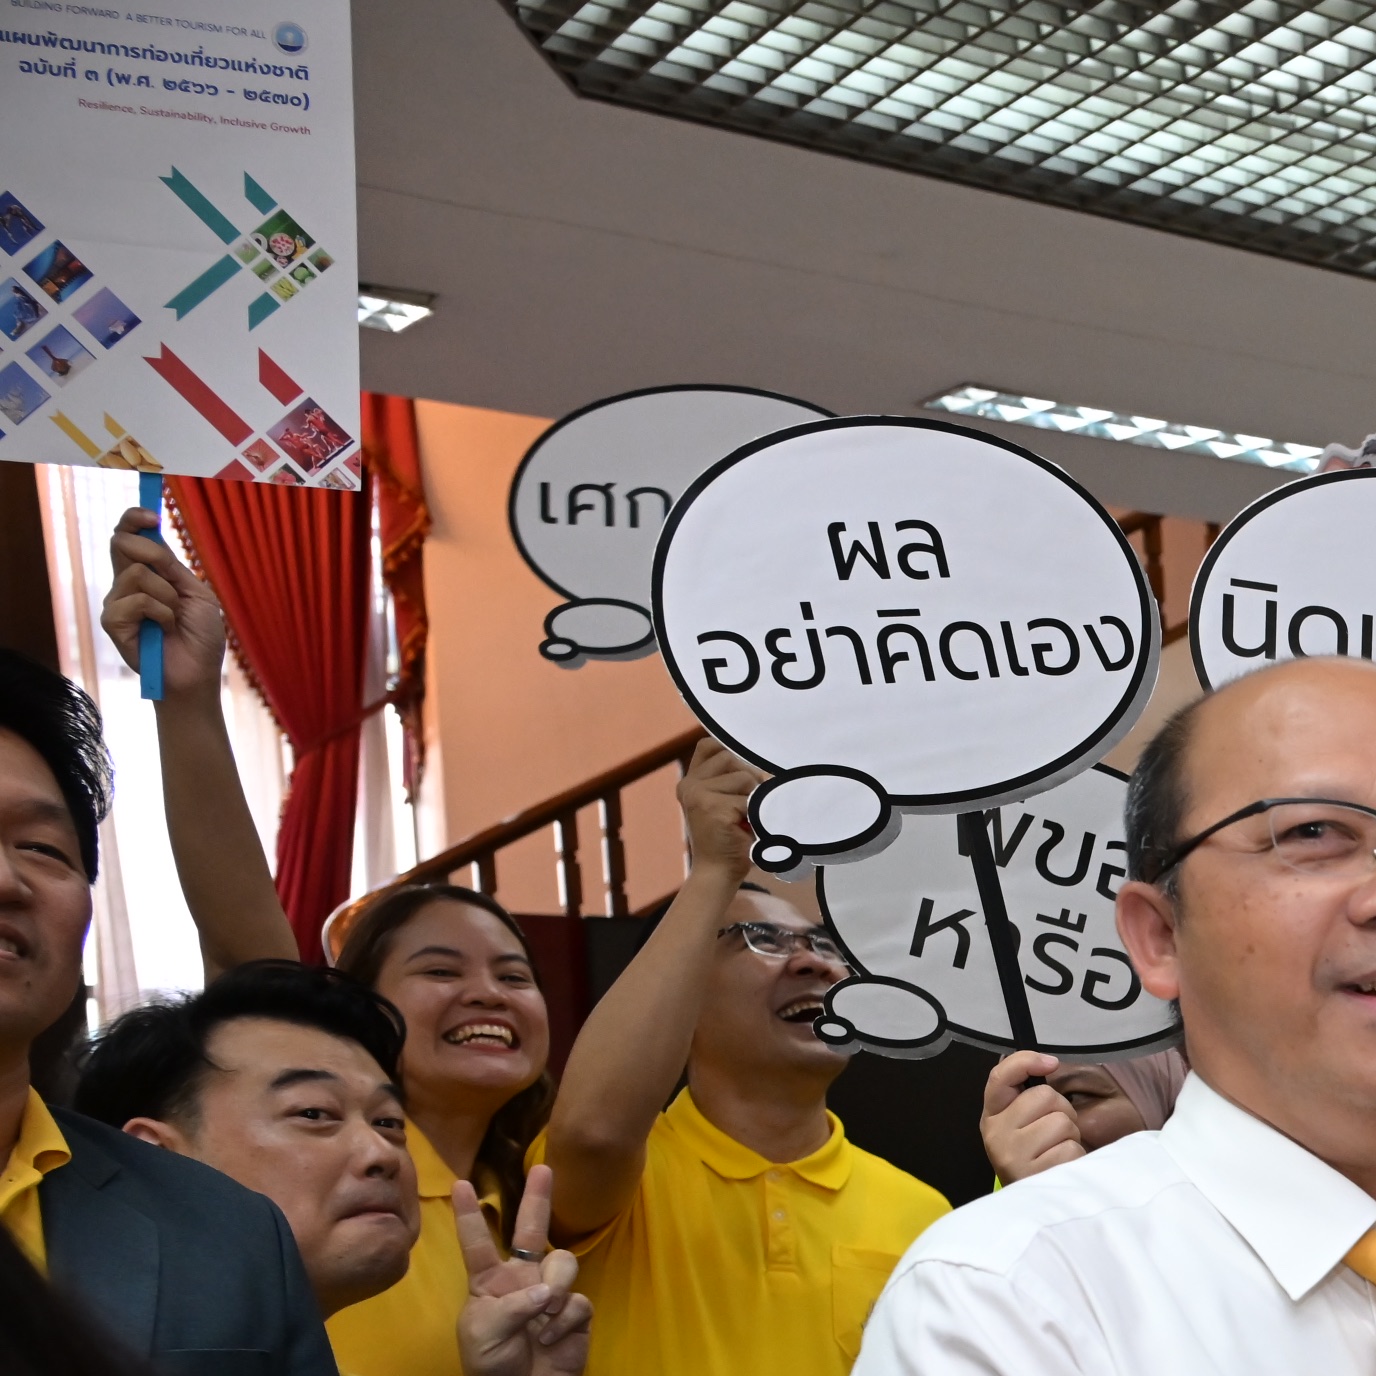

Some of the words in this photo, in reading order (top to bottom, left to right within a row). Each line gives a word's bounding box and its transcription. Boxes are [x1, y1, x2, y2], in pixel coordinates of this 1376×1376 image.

[66, 4, 119, 20] FORWARD
[126, 13, 133, 21] A
[136, 13, 172, 26] BETTER
[175, 18, 223, 33] TOURISM
[226, 25, 247, 36] FOR
[250, 29, 267, 39] ALL
[19, 57, 76, 79] ฉบับที่
[85, 69, 99, 81] ๓
[107, 67, 155, 88] (พ.ศ.
[78, 98, 136, 115] Resilience,
[140, 105, 216, 124] Sustainability,
[220, 115, 267, 130] Inclusive
[270, 122, 311, 135] Growth
[827, 519, 951, 582] ผล
[697, 601, 1136, 694] อย่าคิดเอง
